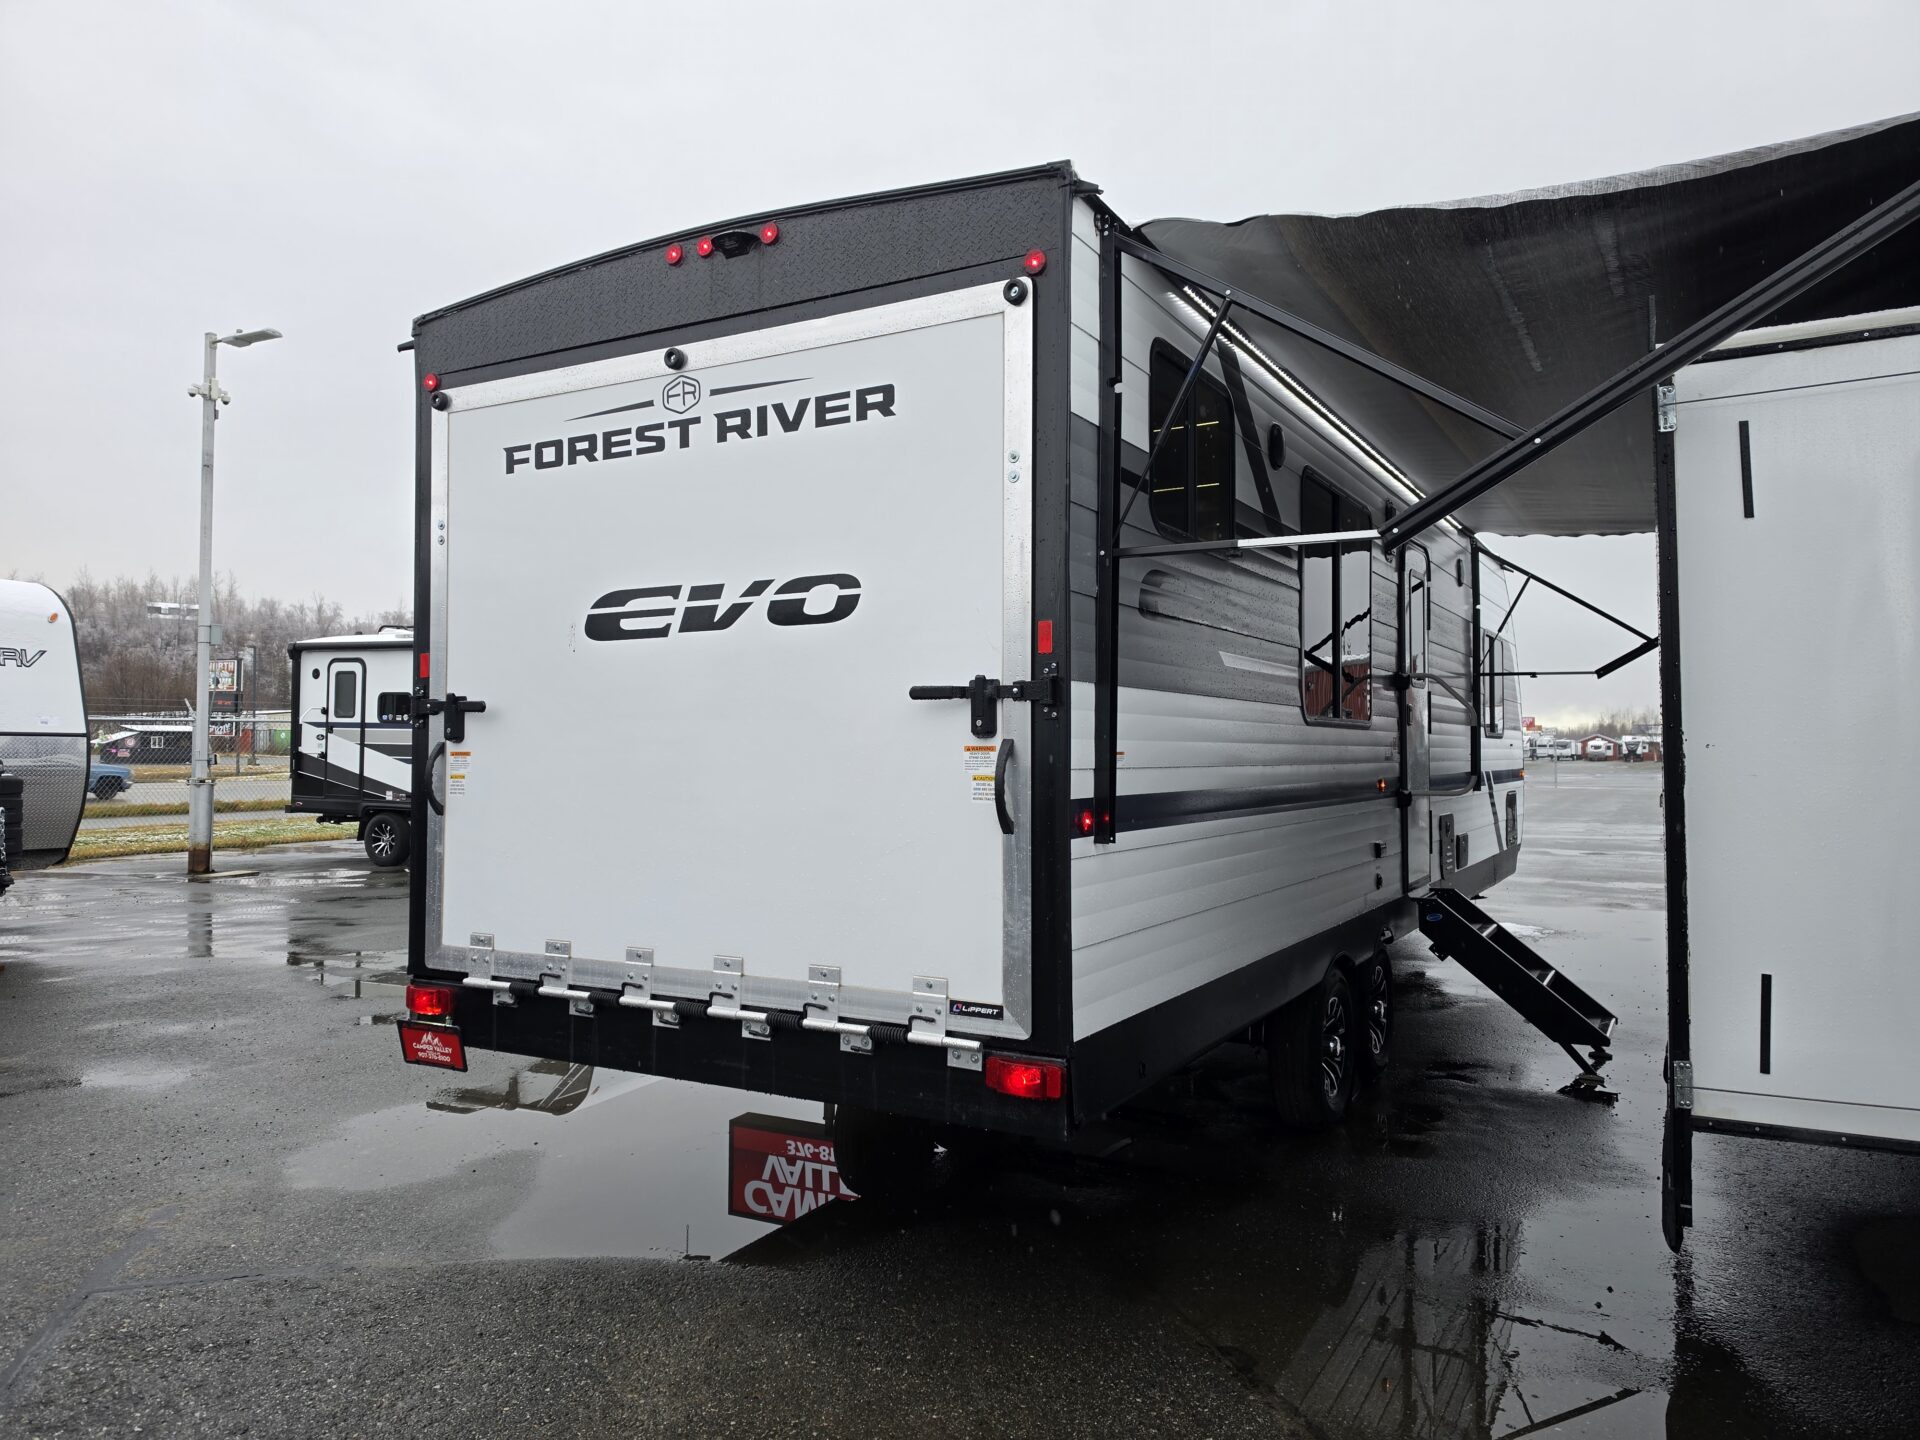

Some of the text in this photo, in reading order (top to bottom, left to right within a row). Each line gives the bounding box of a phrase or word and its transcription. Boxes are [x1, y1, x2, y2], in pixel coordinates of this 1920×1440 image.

[503, 383, 896, 475] FOREST RIVER
[584, 573, 862, 642] EVO
